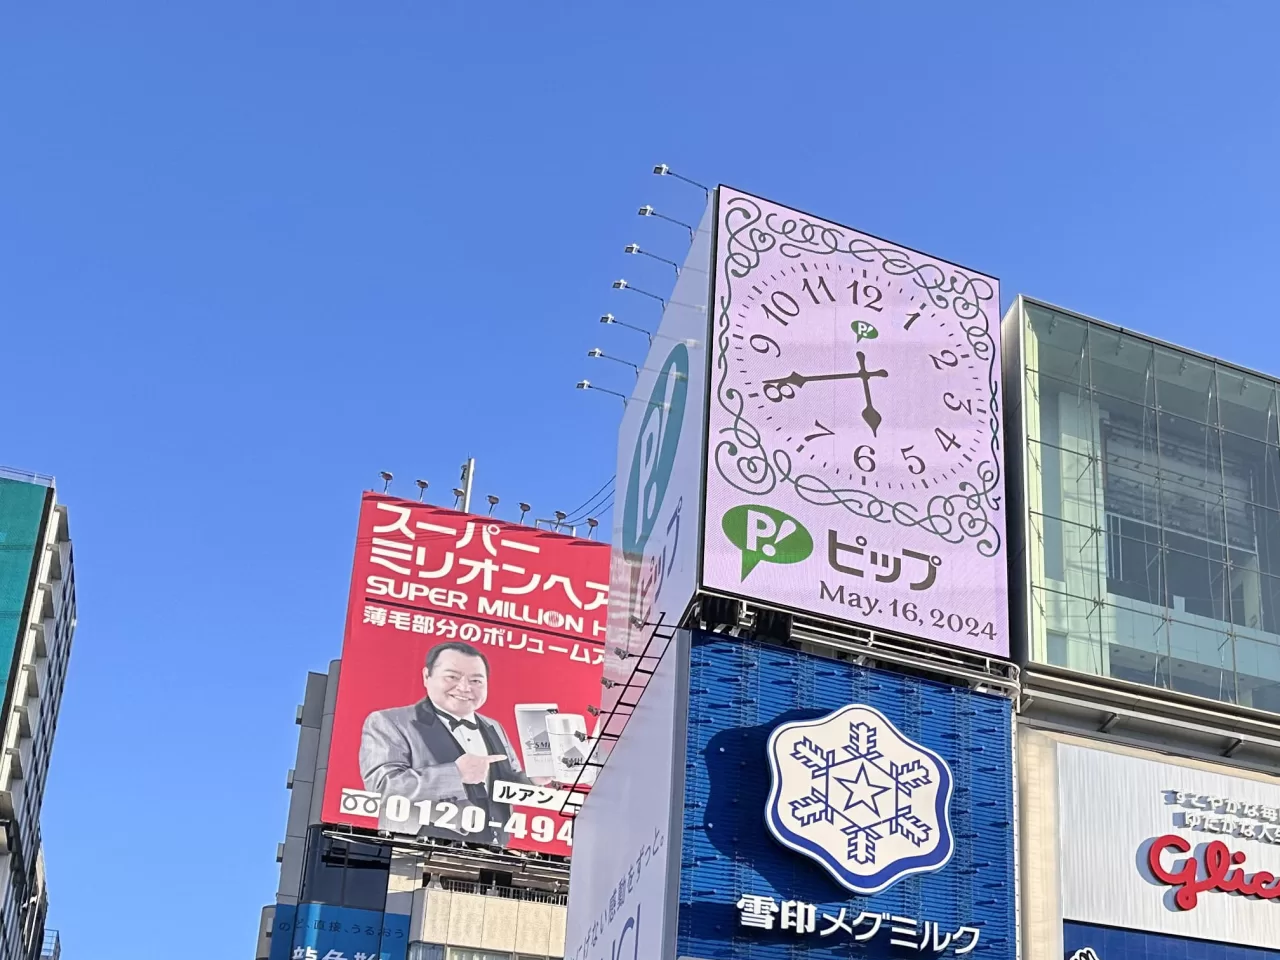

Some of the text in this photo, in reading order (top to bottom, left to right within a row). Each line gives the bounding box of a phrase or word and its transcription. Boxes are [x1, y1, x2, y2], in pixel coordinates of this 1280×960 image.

[801, 275, 836, 306] 11
[846, 280, 884, 313] 12
[761, 291, 800, 327] 10
[903, 312, 920, 332] 1
[749, 334, 781, 358] 9
[929, 348, 959, 371] 2
[943, 392, 972, 416] 3
[804, 420, 835, 443] 7
[935, 427, 961, 453] 4
[853, 445, 875, 473] 6
[901, 445, 926, 475] 5
[371, 502, 541, 557] スーパー
[370, 537, 610, 610] ミリオンヘア
[827, 528, 943, 591] ピップ
[366, 575, 584, 634] SUPER MILLION
[819, 580, 997, 641] May. 16, 2024
[498, 785, 554, 804] ルアン
[385, 795, 574, 846] 0120-494
[736, 893, 981, 955] 雪印メグミルク
